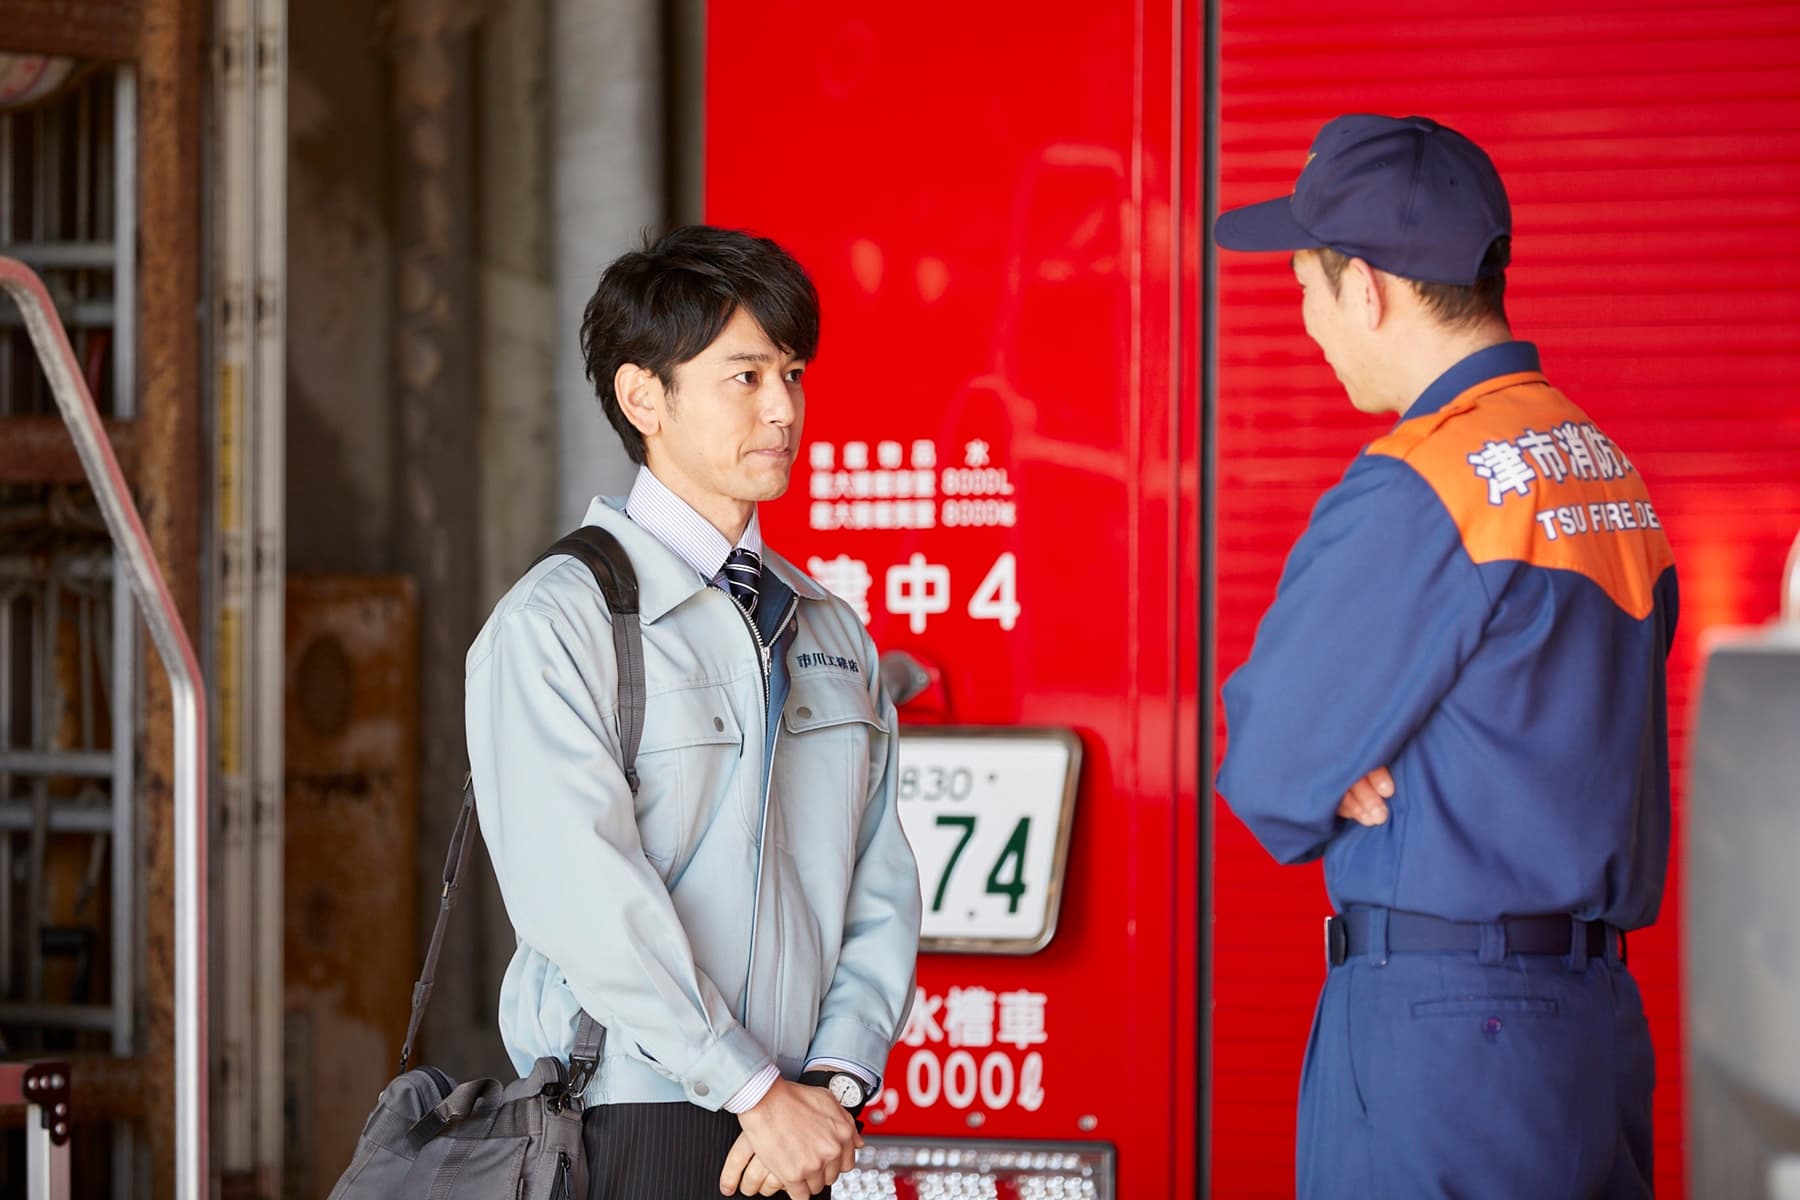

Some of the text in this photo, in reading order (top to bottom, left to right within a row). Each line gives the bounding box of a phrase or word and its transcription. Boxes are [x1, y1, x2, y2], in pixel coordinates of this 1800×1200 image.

[1467, 419, 1633, 505] 津市消防
[1535, 503, 1588, 541] TSU
[1588, 502, 1637, 533] FIRE
[899, 765, 974, 801] 830
[931, 815, 1031, 914] 74
